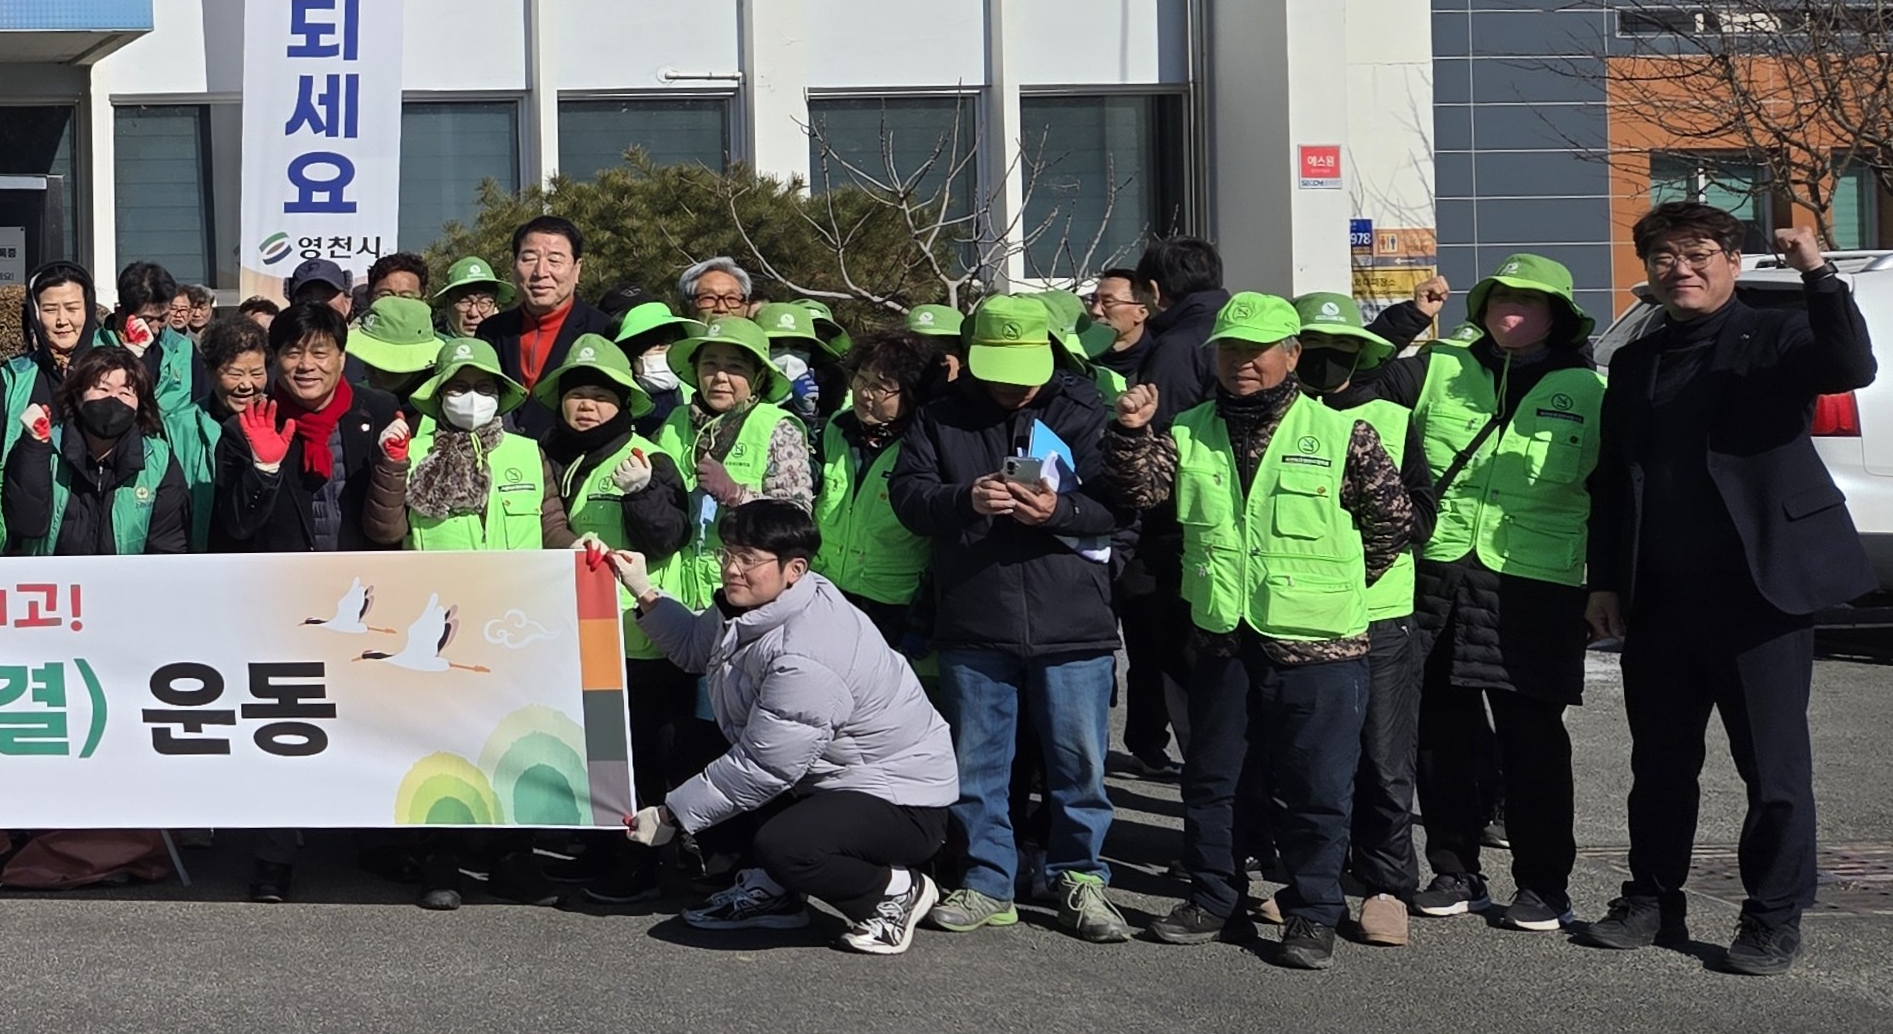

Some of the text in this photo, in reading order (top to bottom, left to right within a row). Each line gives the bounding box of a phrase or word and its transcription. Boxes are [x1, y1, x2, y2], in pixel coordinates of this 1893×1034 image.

[1307, 155, 1335, 167] 에스원
[1350, 232, 1371, 244] 978
[298, 236, 381, 260] 영천시
[141, 661, 337, 757] 운동
